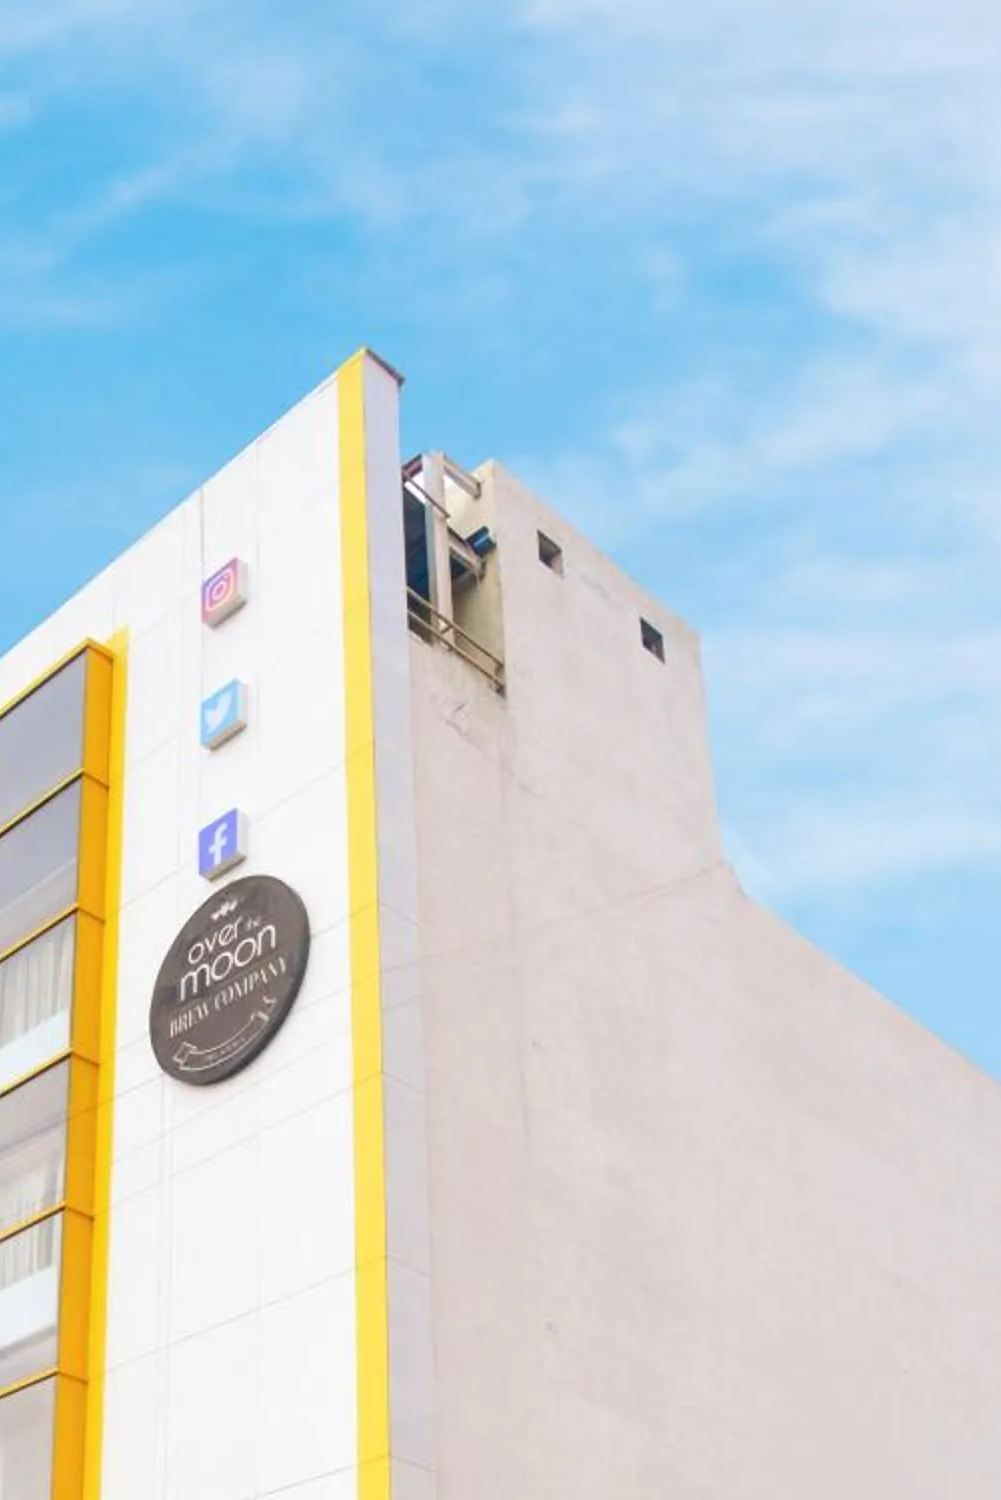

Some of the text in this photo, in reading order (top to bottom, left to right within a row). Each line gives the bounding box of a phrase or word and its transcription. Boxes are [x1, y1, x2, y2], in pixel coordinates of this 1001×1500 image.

[181, 925, 276, 1001] moon
[188, 917, 242, 965] over
[170, 957, 286, 1037] BREW COMPANY
